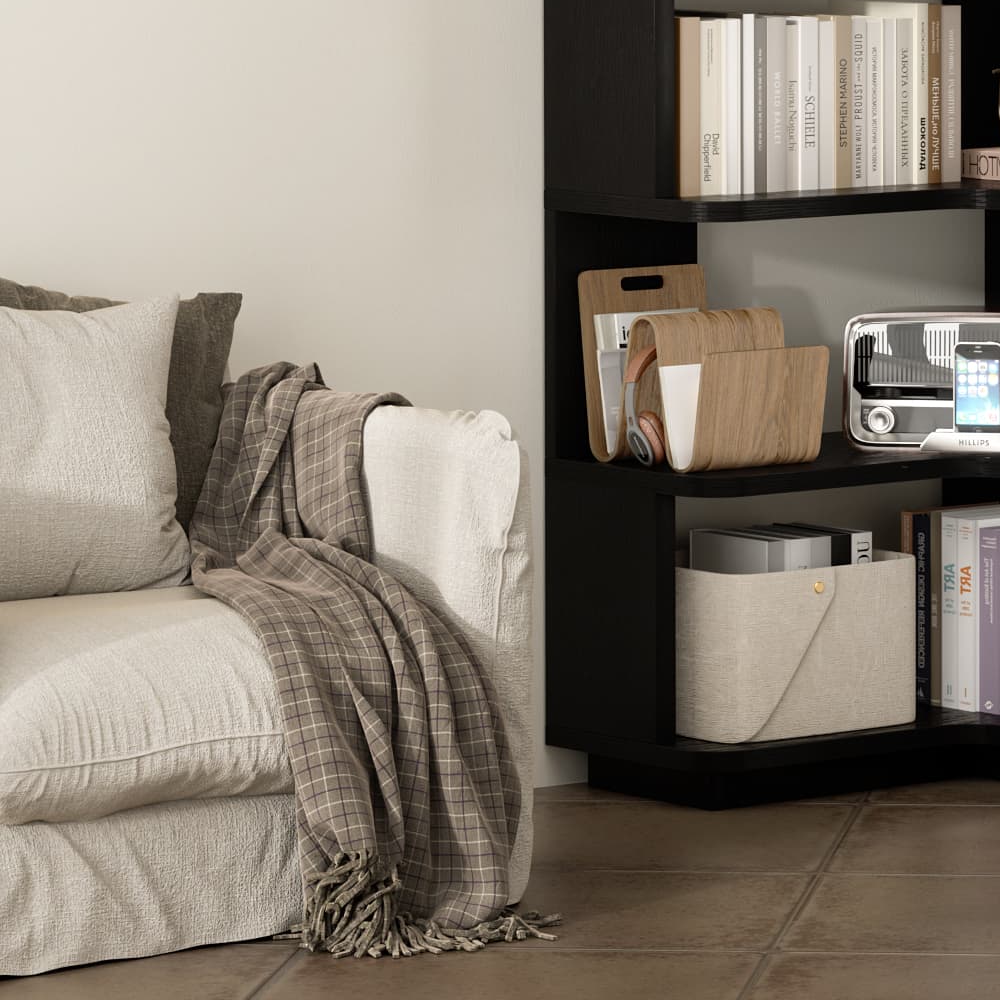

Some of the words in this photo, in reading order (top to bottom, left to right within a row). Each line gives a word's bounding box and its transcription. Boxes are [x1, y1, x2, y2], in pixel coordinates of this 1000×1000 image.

[854, 33, 863, 63] SQUID
[839, 58, 848, 100] MARINO
[854, 84, 863, 120] PROUST
[804, 96, 816, 149] SCHIELE
[839, 102, 848, 148] STEPHEN
[702, 133, 712, 182] Chipperfield
[712, 133, 720, 156] David
[931, 137, 940, 172] ЛУЧШЕ
